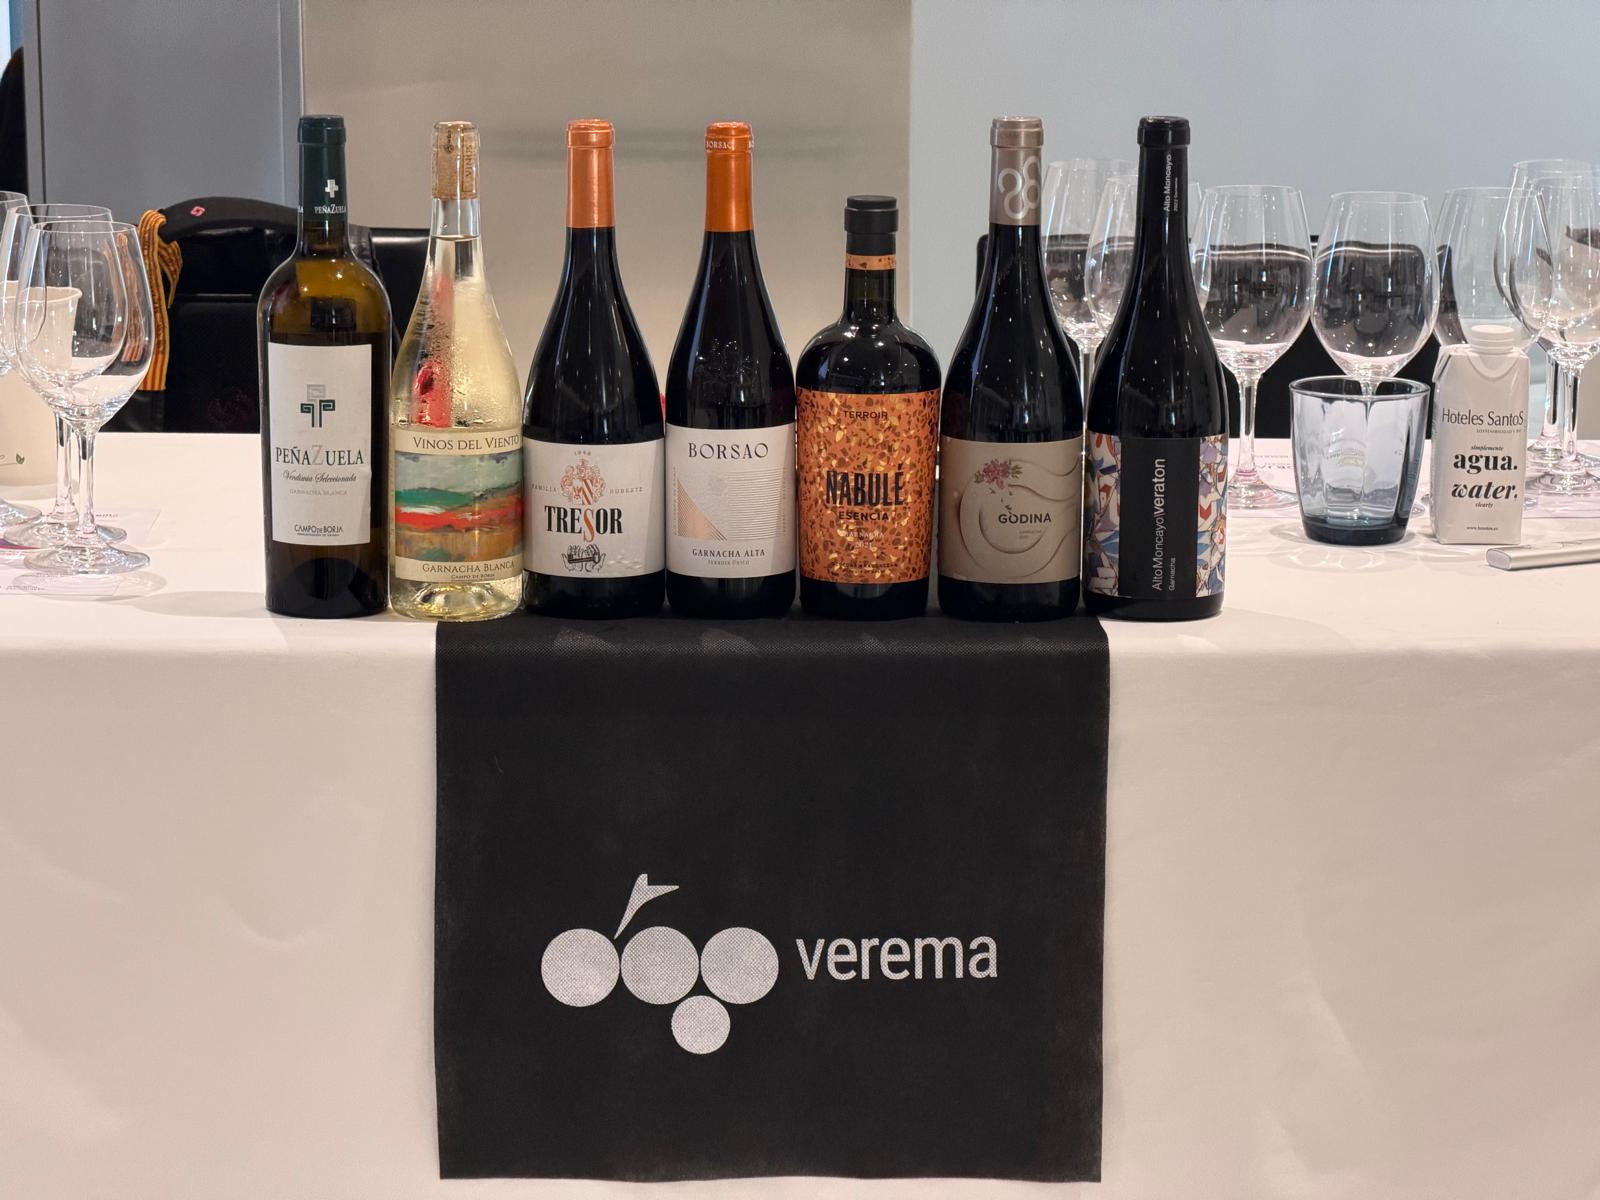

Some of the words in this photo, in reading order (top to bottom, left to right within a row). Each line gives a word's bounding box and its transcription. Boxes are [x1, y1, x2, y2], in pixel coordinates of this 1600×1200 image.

[1163, 154, 1173, 194] Moncayo
[1163, 195, 1171, 212] Alto
[843, 410, 888, 419] TERROIR
[1442, 408, 1484, 426] Hoteles
[413, 436, 454, 450] VINOS
[458, 439, 482, 450] DEL
[485, 434, 520, 448] VIENTO
[688, 442, 769, 460] BORSAO
[275, 445, 364, 466] PEÑAZUELA
[1453, 453, 1518, 475] agua.
[826, 463, 905, 507] NABULÉ
[1451, 481, 1518, 500] water.
[544, 505, 624, 543] TRESOR
[839, 511, 889, 521] ESENCIA
[294, 524, 317, 533] CAMPO
[323, 525, 343, 533] BORJA
[692, 548, 741, 558] GARNACHA
[744, 548, 766, 557] ALTA
[422, 562, 481, 573] GARNACHA
[484, 560, 515, 572] BLANCA
[1168, 557, 1176, 591] Garnacha
[795, 936, 998, 980] verema
